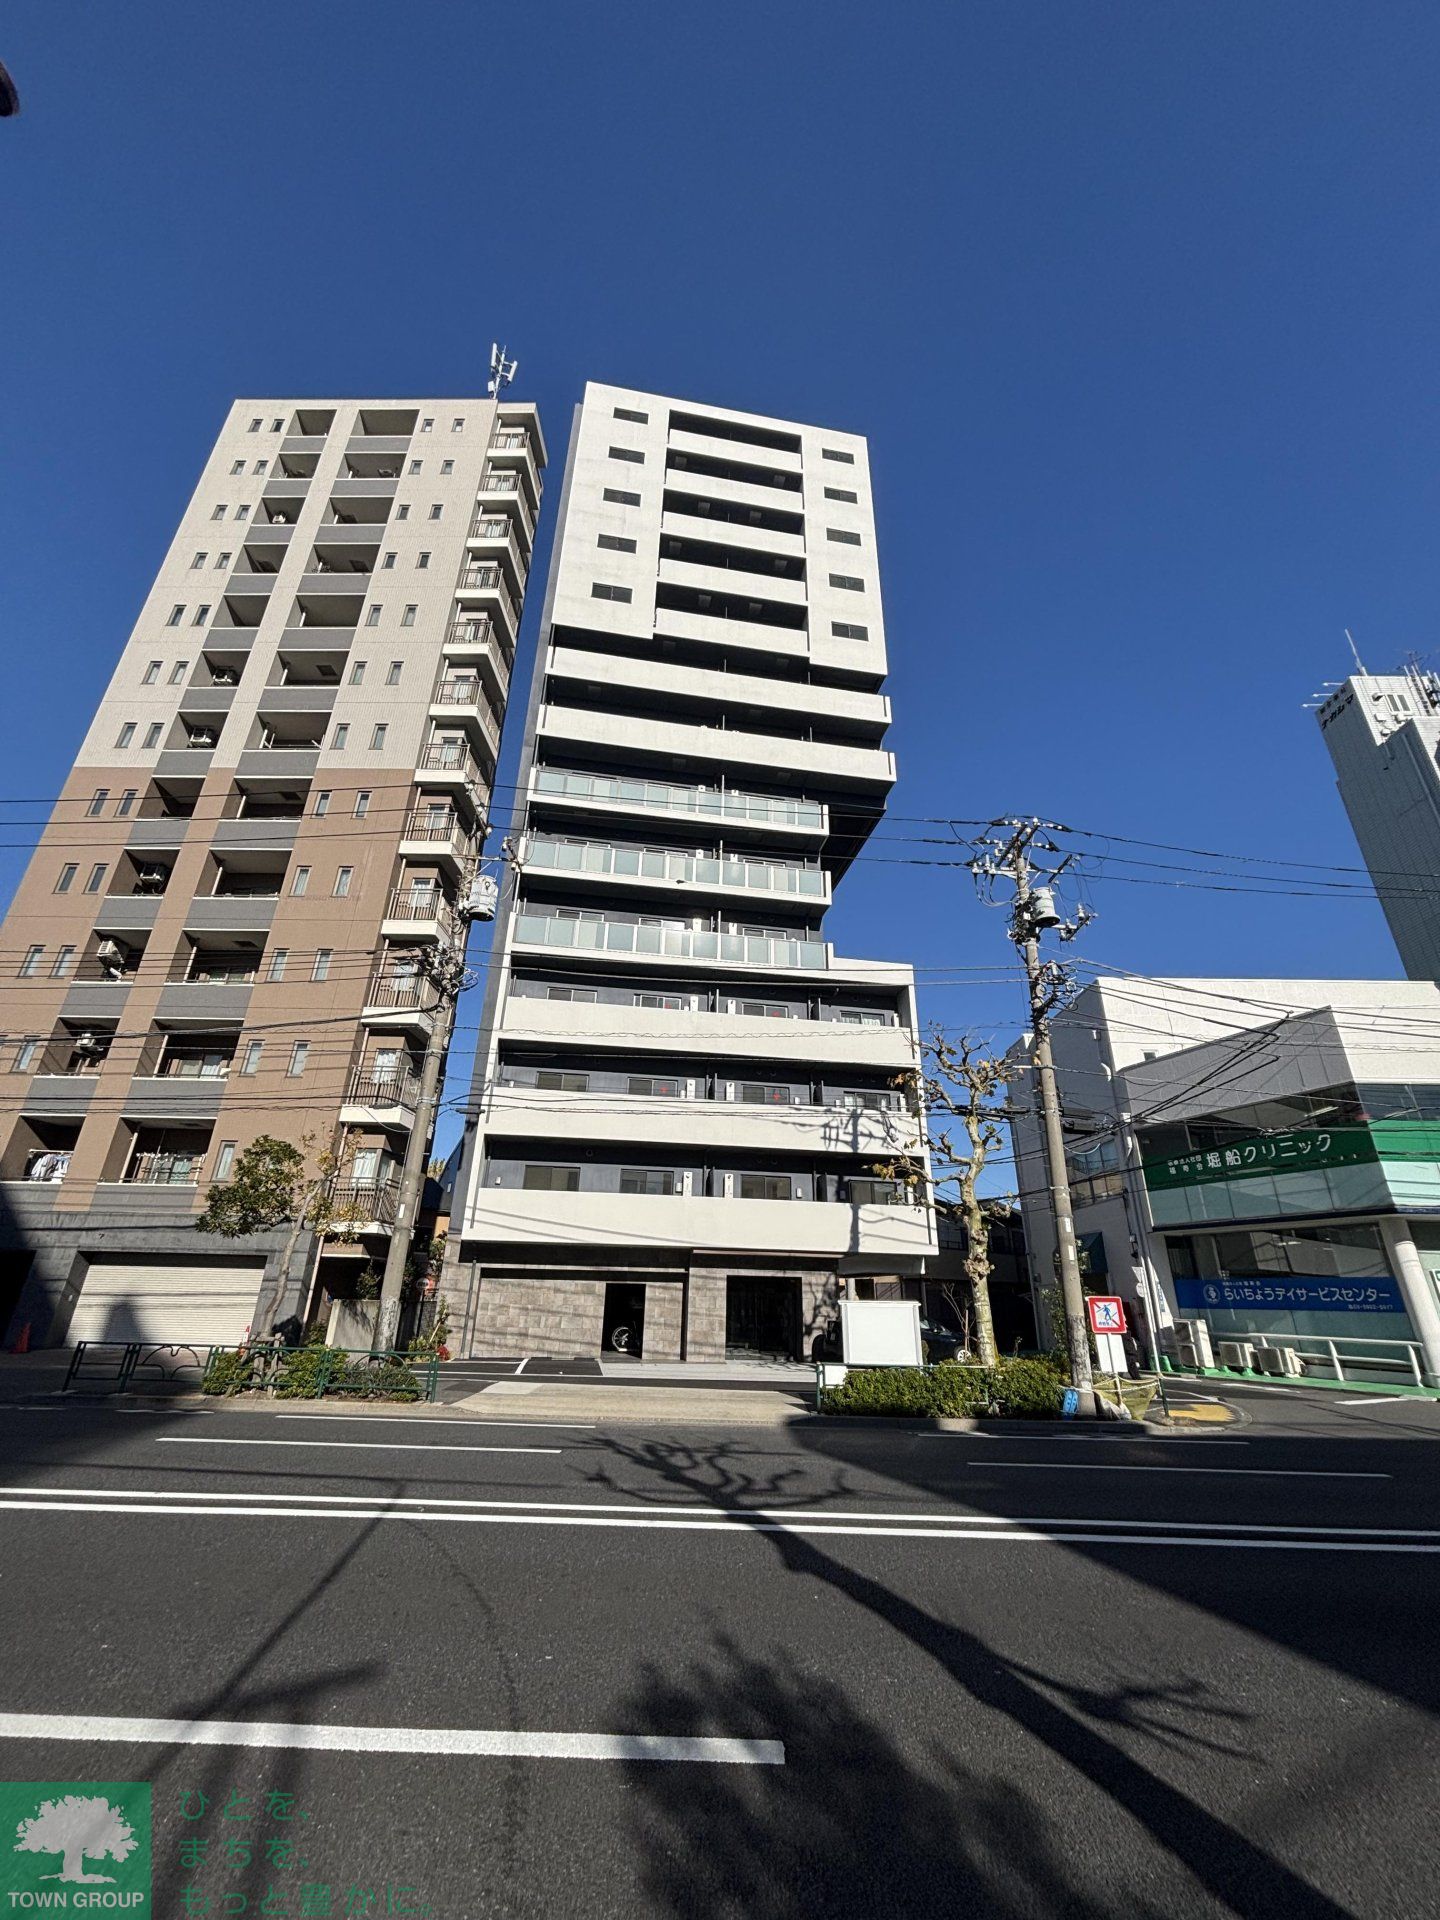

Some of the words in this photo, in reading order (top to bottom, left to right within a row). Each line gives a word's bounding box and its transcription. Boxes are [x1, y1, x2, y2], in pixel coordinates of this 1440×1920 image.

[1206, 1134, 1332, 1168] 堀船クリニック
[1224, 1287, 1391, 1303] らいちょうデイサービスセンター
